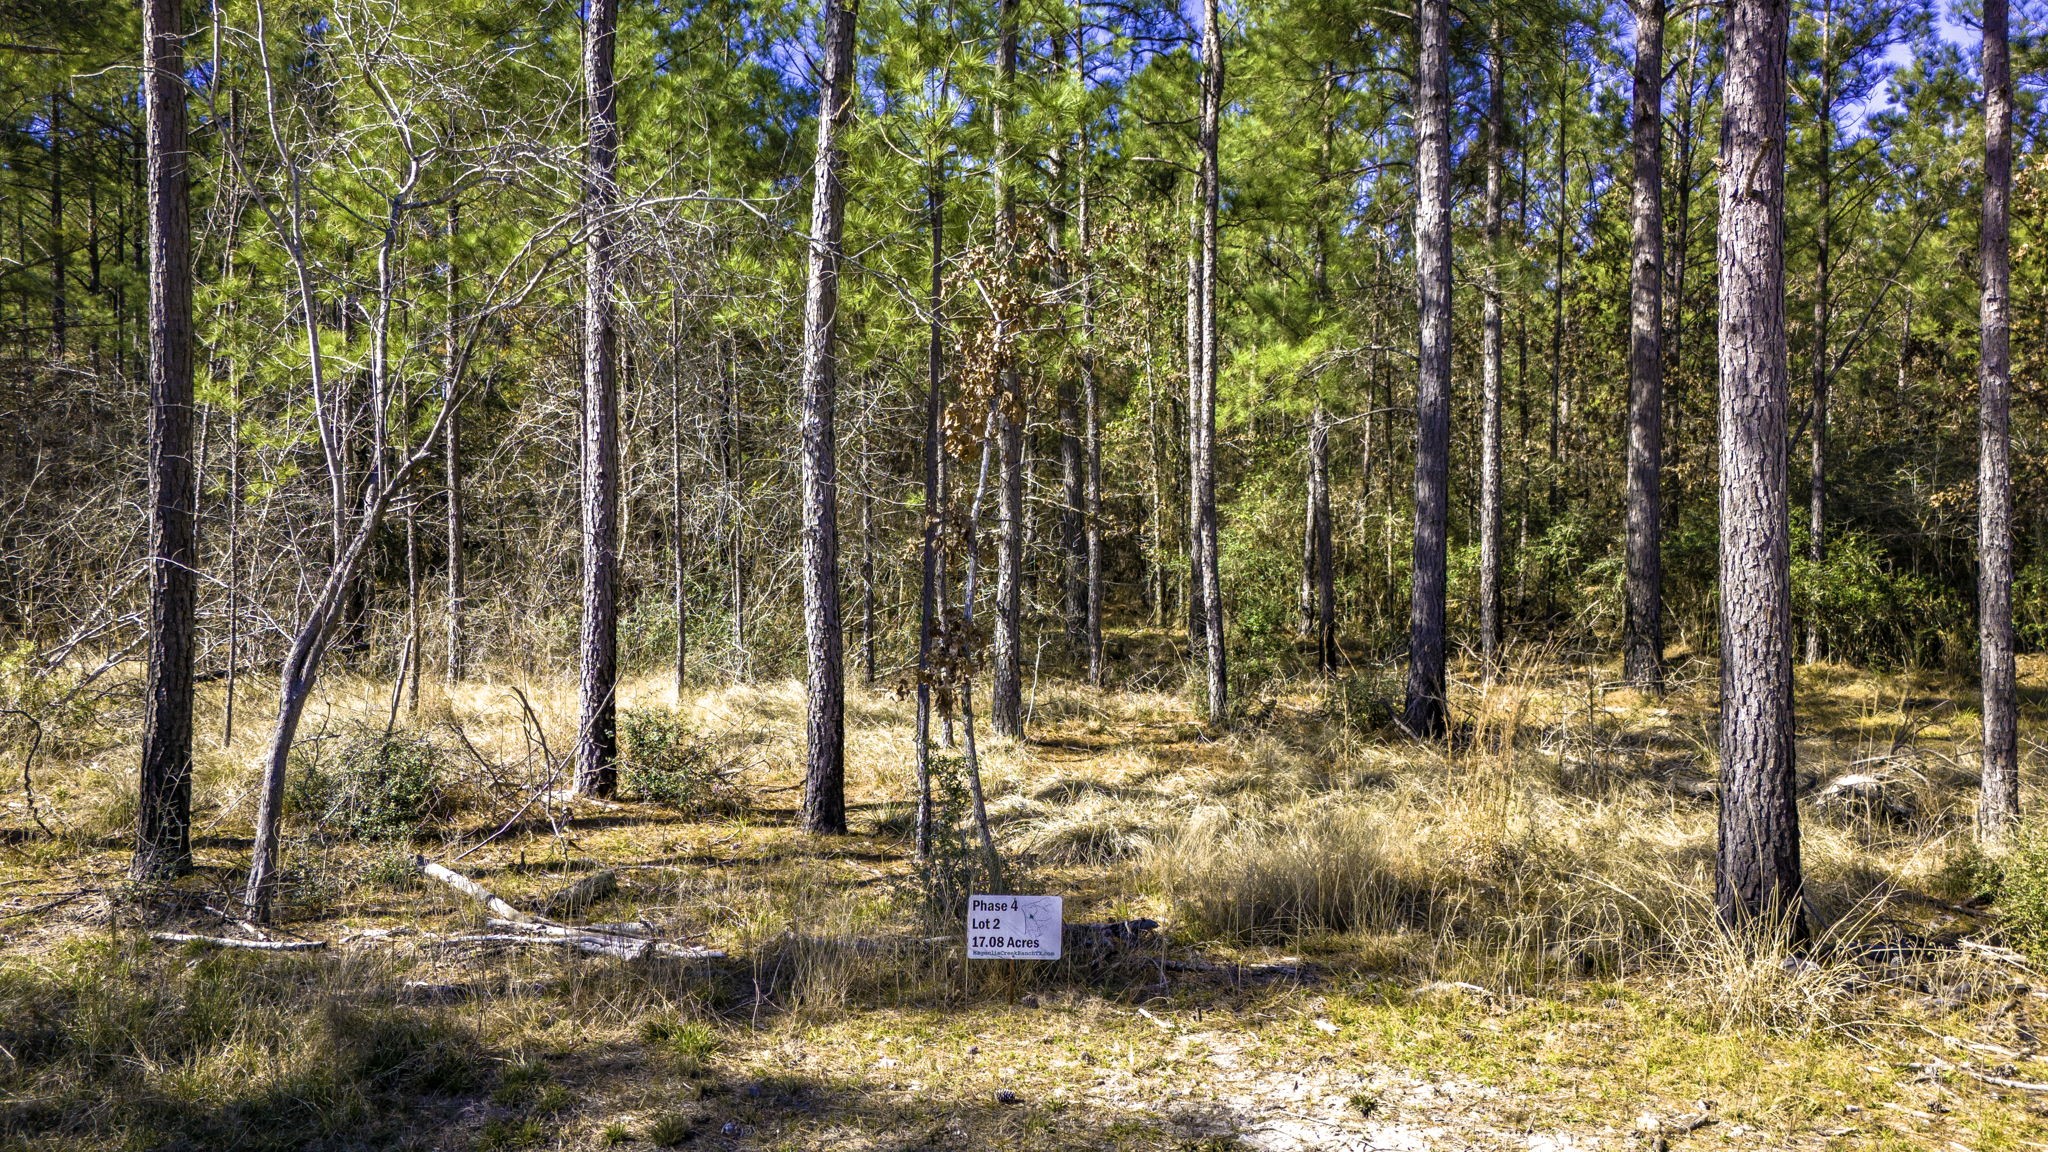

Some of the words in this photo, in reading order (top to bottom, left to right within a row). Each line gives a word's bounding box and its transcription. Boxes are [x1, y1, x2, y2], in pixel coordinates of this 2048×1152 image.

[972, 900, 1008, 912] Phase
[1010, 900, 1018, 912] 4
[972, 918, 990, 930] Lot
[992, 918, 1001, 930] 2
[972, 936, 1004, 948] 17.08
[1006, 936, 1040, 948] Acres
